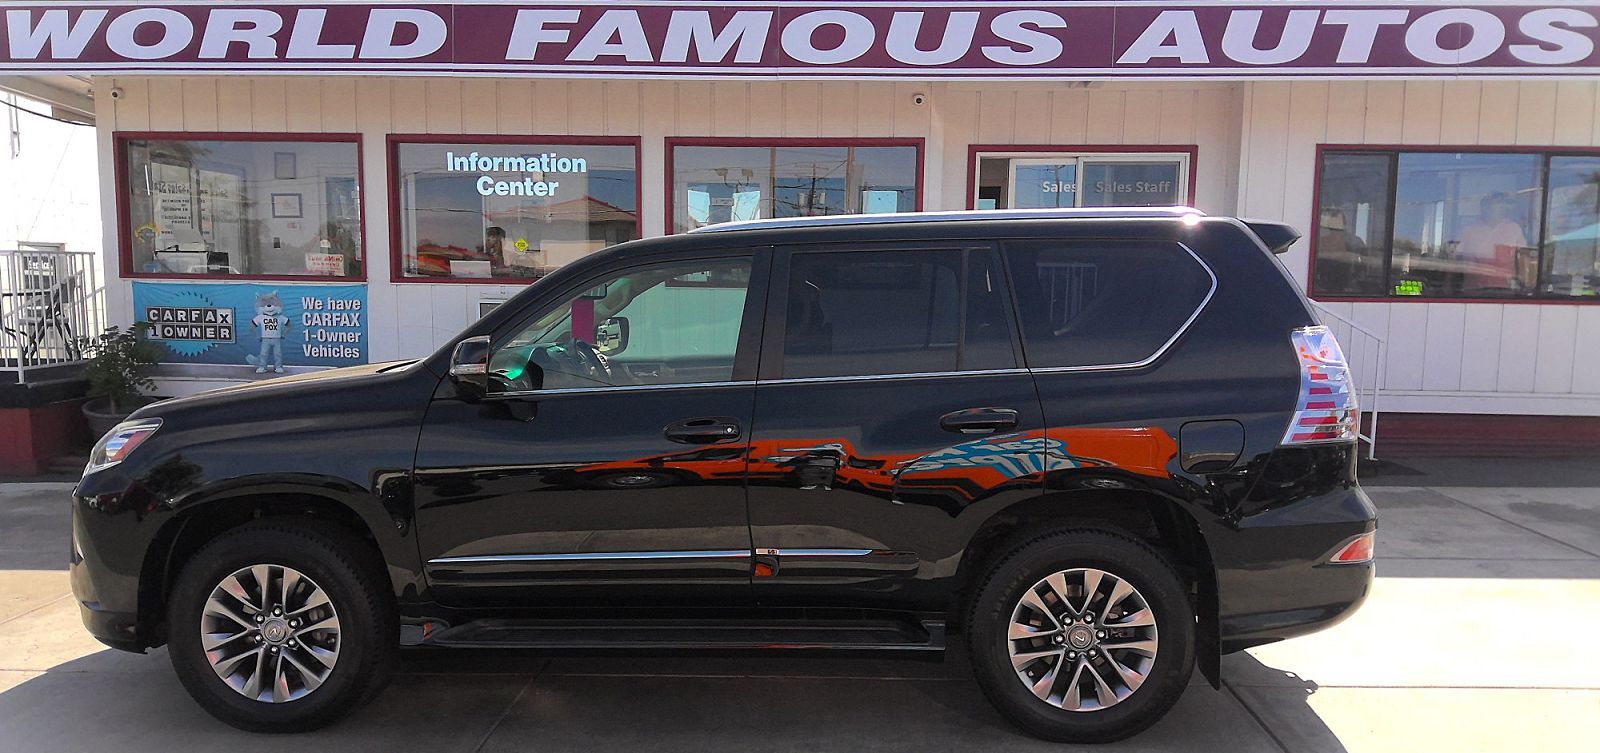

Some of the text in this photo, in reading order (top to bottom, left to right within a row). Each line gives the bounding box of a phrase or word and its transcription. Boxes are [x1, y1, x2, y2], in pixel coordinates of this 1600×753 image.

[5, 8, 1599, 65] WORLD FAMOUS AUTOS
[446, 151, 587, 173] Information
[476, 175, 559, 197] Center
[1042, 181, 1076, 193] Sales
[1095, 181, 1171, 193] Sales Staff
[301, 296, 361, 310] We have
[148, 309, 231, 324] CARFAX
[301, 312, 361, 327] CARFAX
[164, 327, 231, 339] OWNER
[302, 329, 362, 344] 1-Owner
[302, 344, 360, 358] Vehicles
